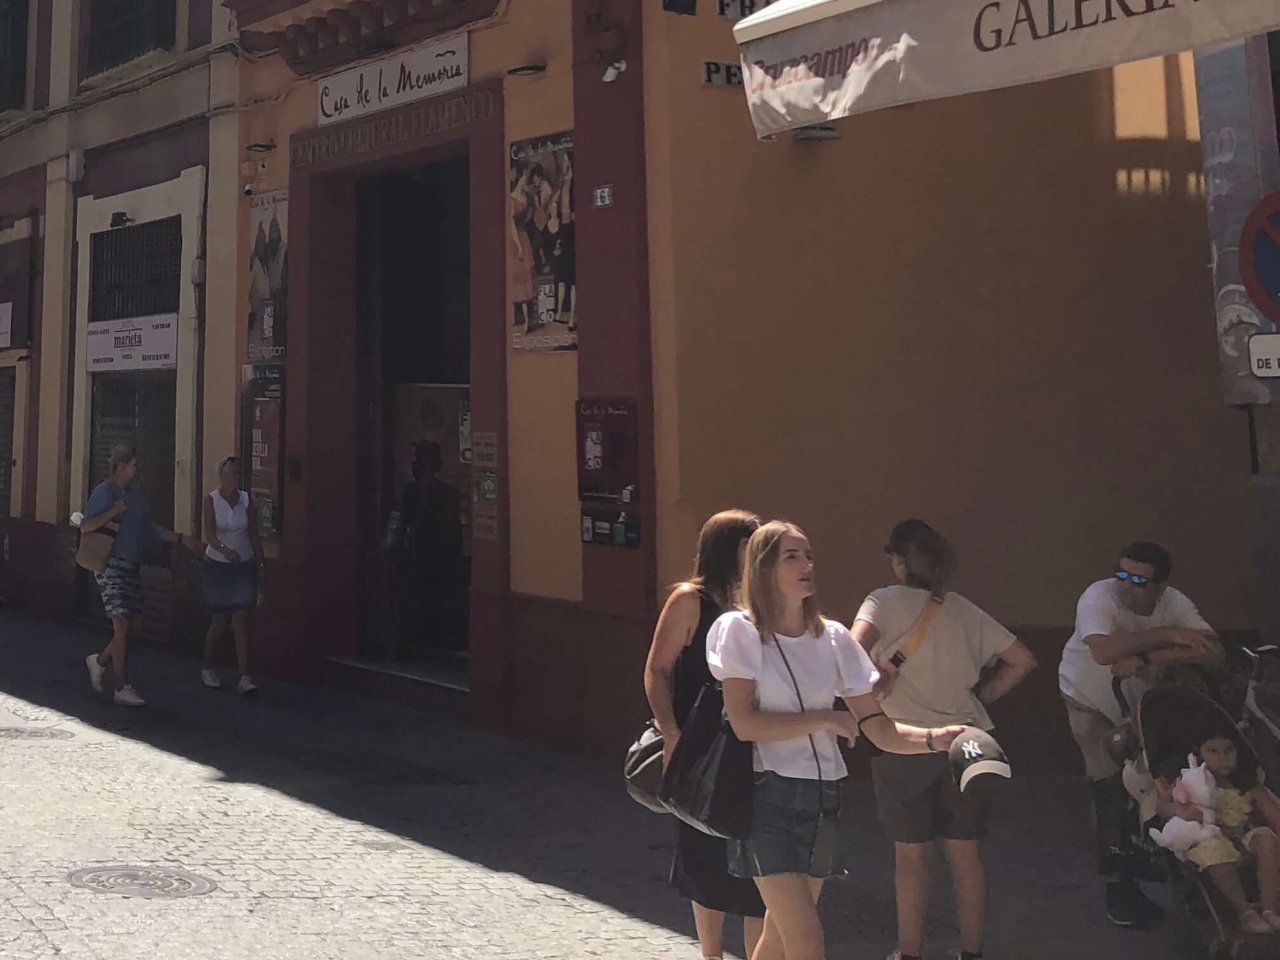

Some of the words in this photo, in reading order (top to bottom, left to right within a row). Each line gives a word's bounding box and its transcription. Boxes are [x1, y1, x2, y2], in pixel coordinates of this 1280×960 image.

[320, 85, 350, 118] Casa
[357, 72, 371, 109] de
[378, 68, 389, 103] la
[1256, 358, 1272, 370] DE
